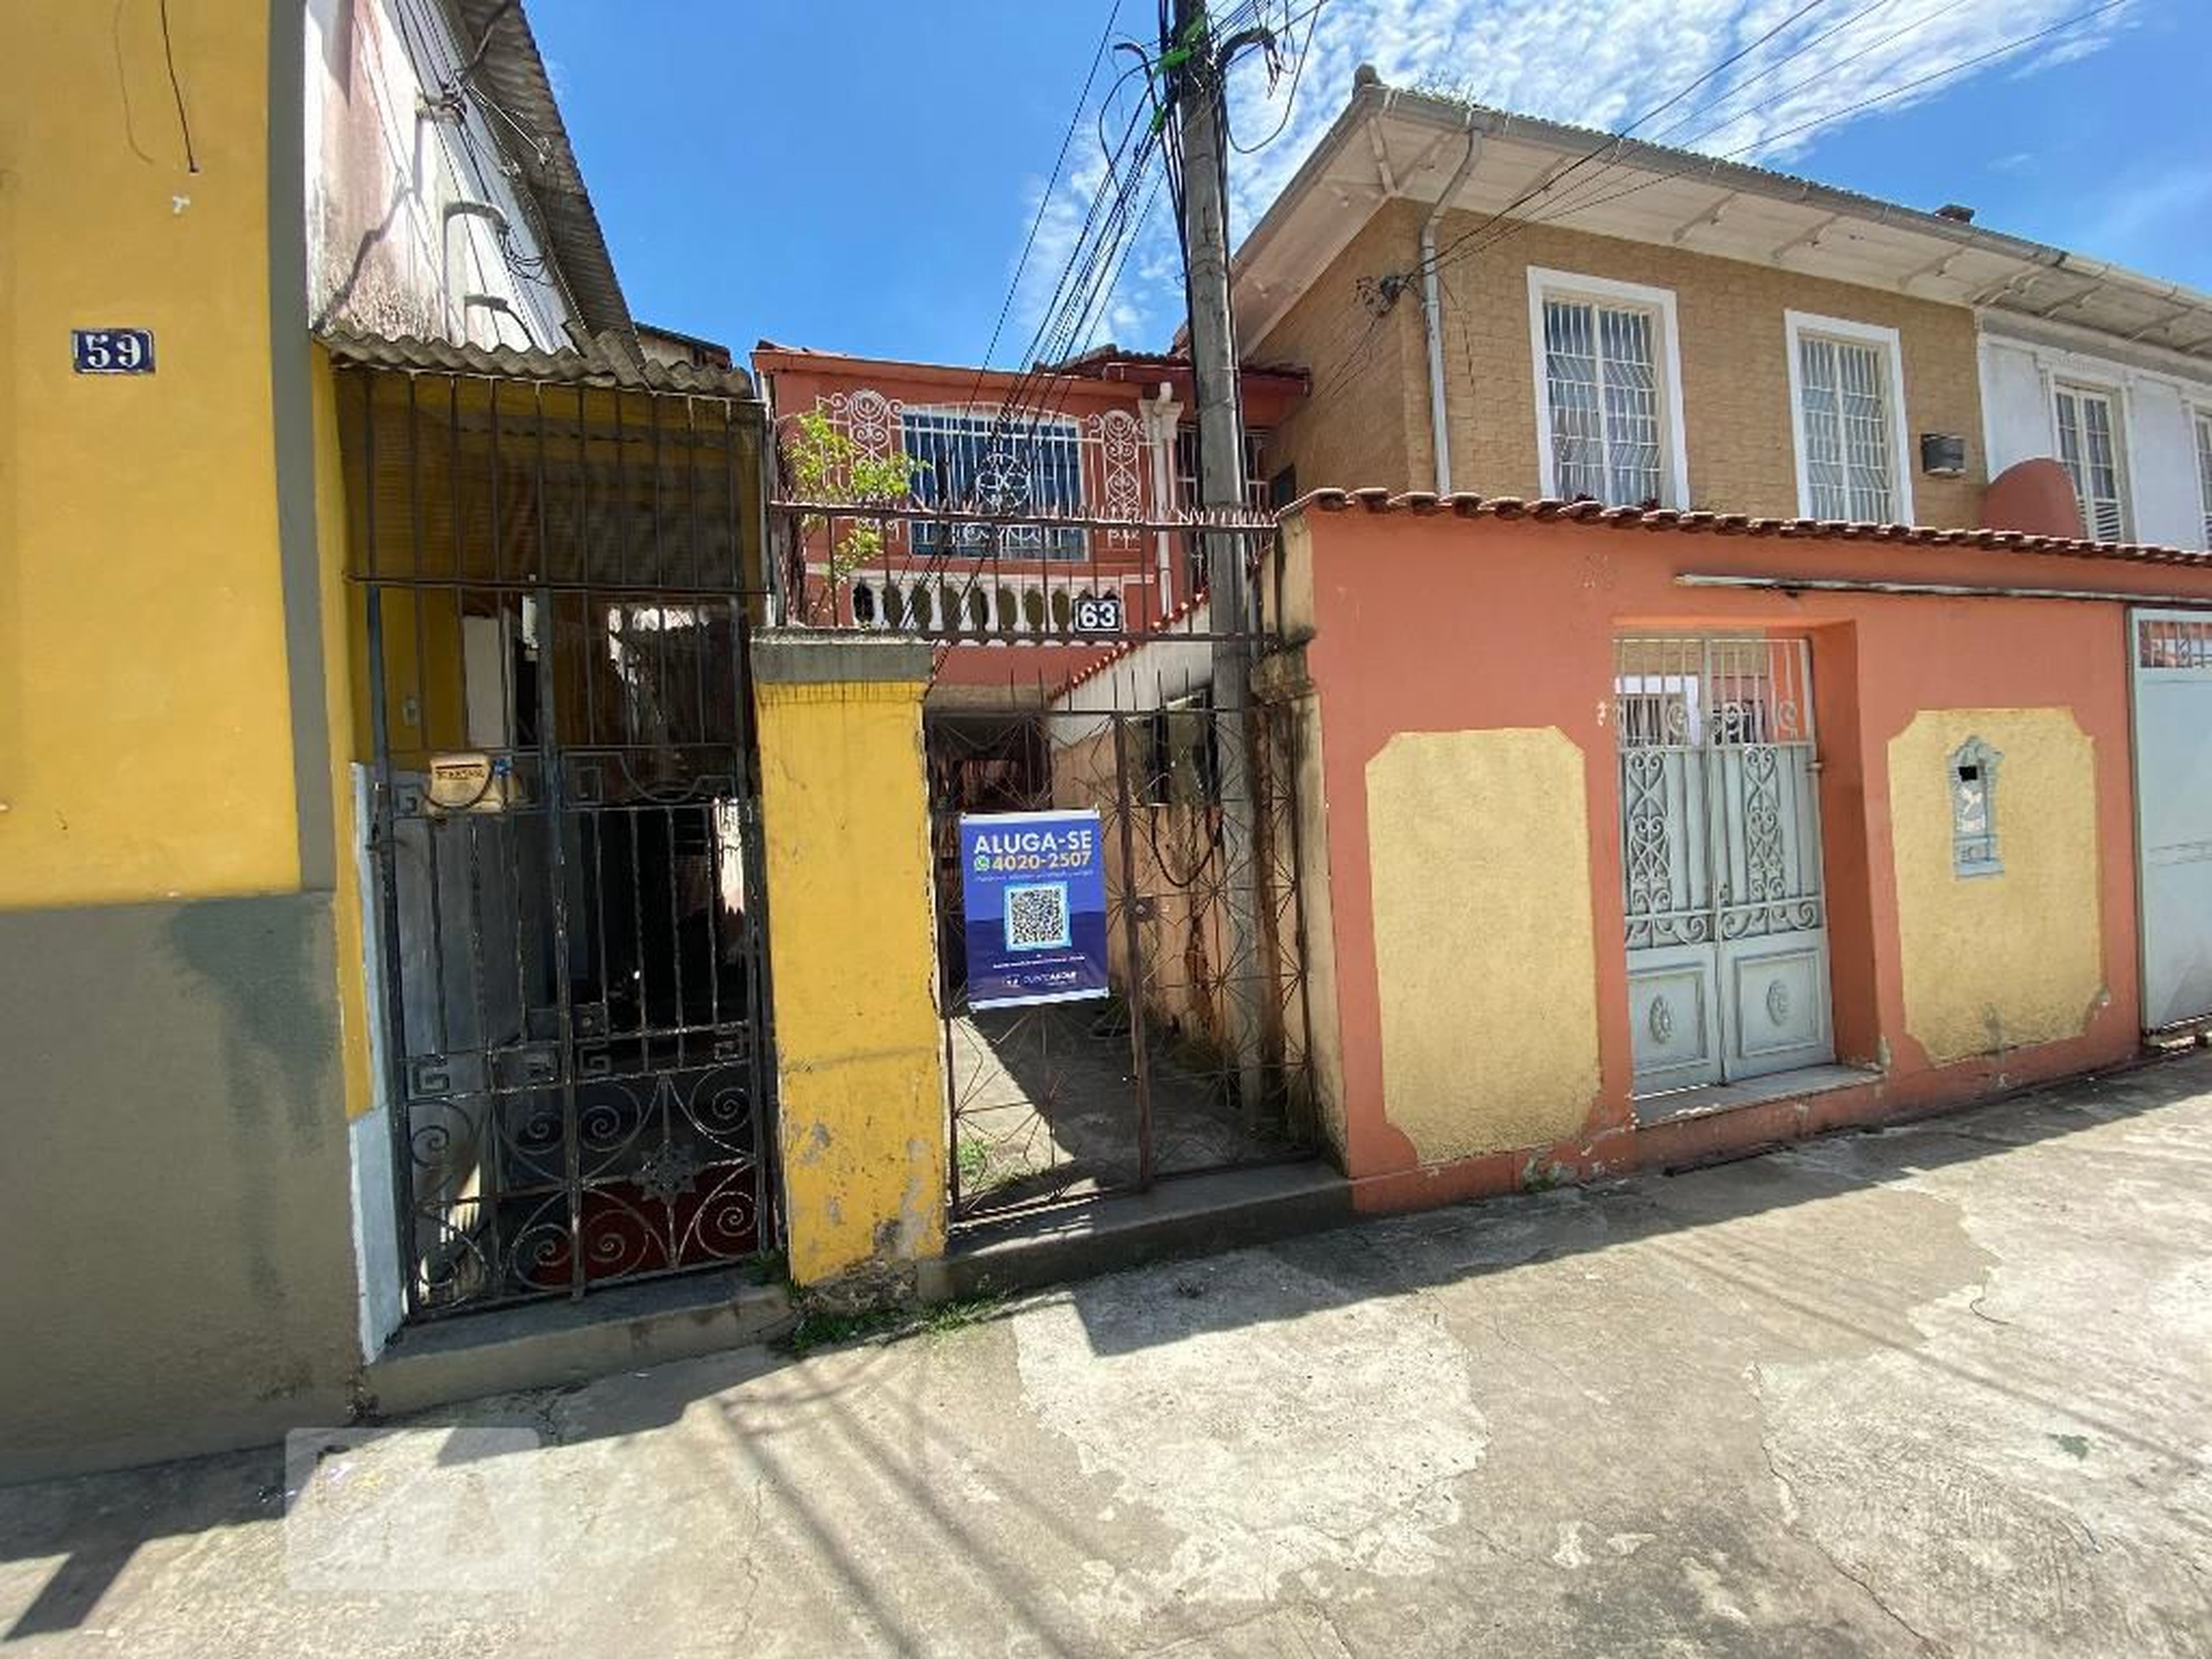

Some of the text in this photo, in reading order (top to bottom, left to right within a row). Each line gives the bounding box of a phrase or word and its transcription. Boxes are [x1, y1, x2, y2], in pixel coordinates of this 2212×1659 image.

[86, 334, 141, 368] 59
[1080, 602, 1115, 627] 63
[974, 830, 1092, 854] ALUGA-SE
[993, 851, 1092, 872] 4020-2507
